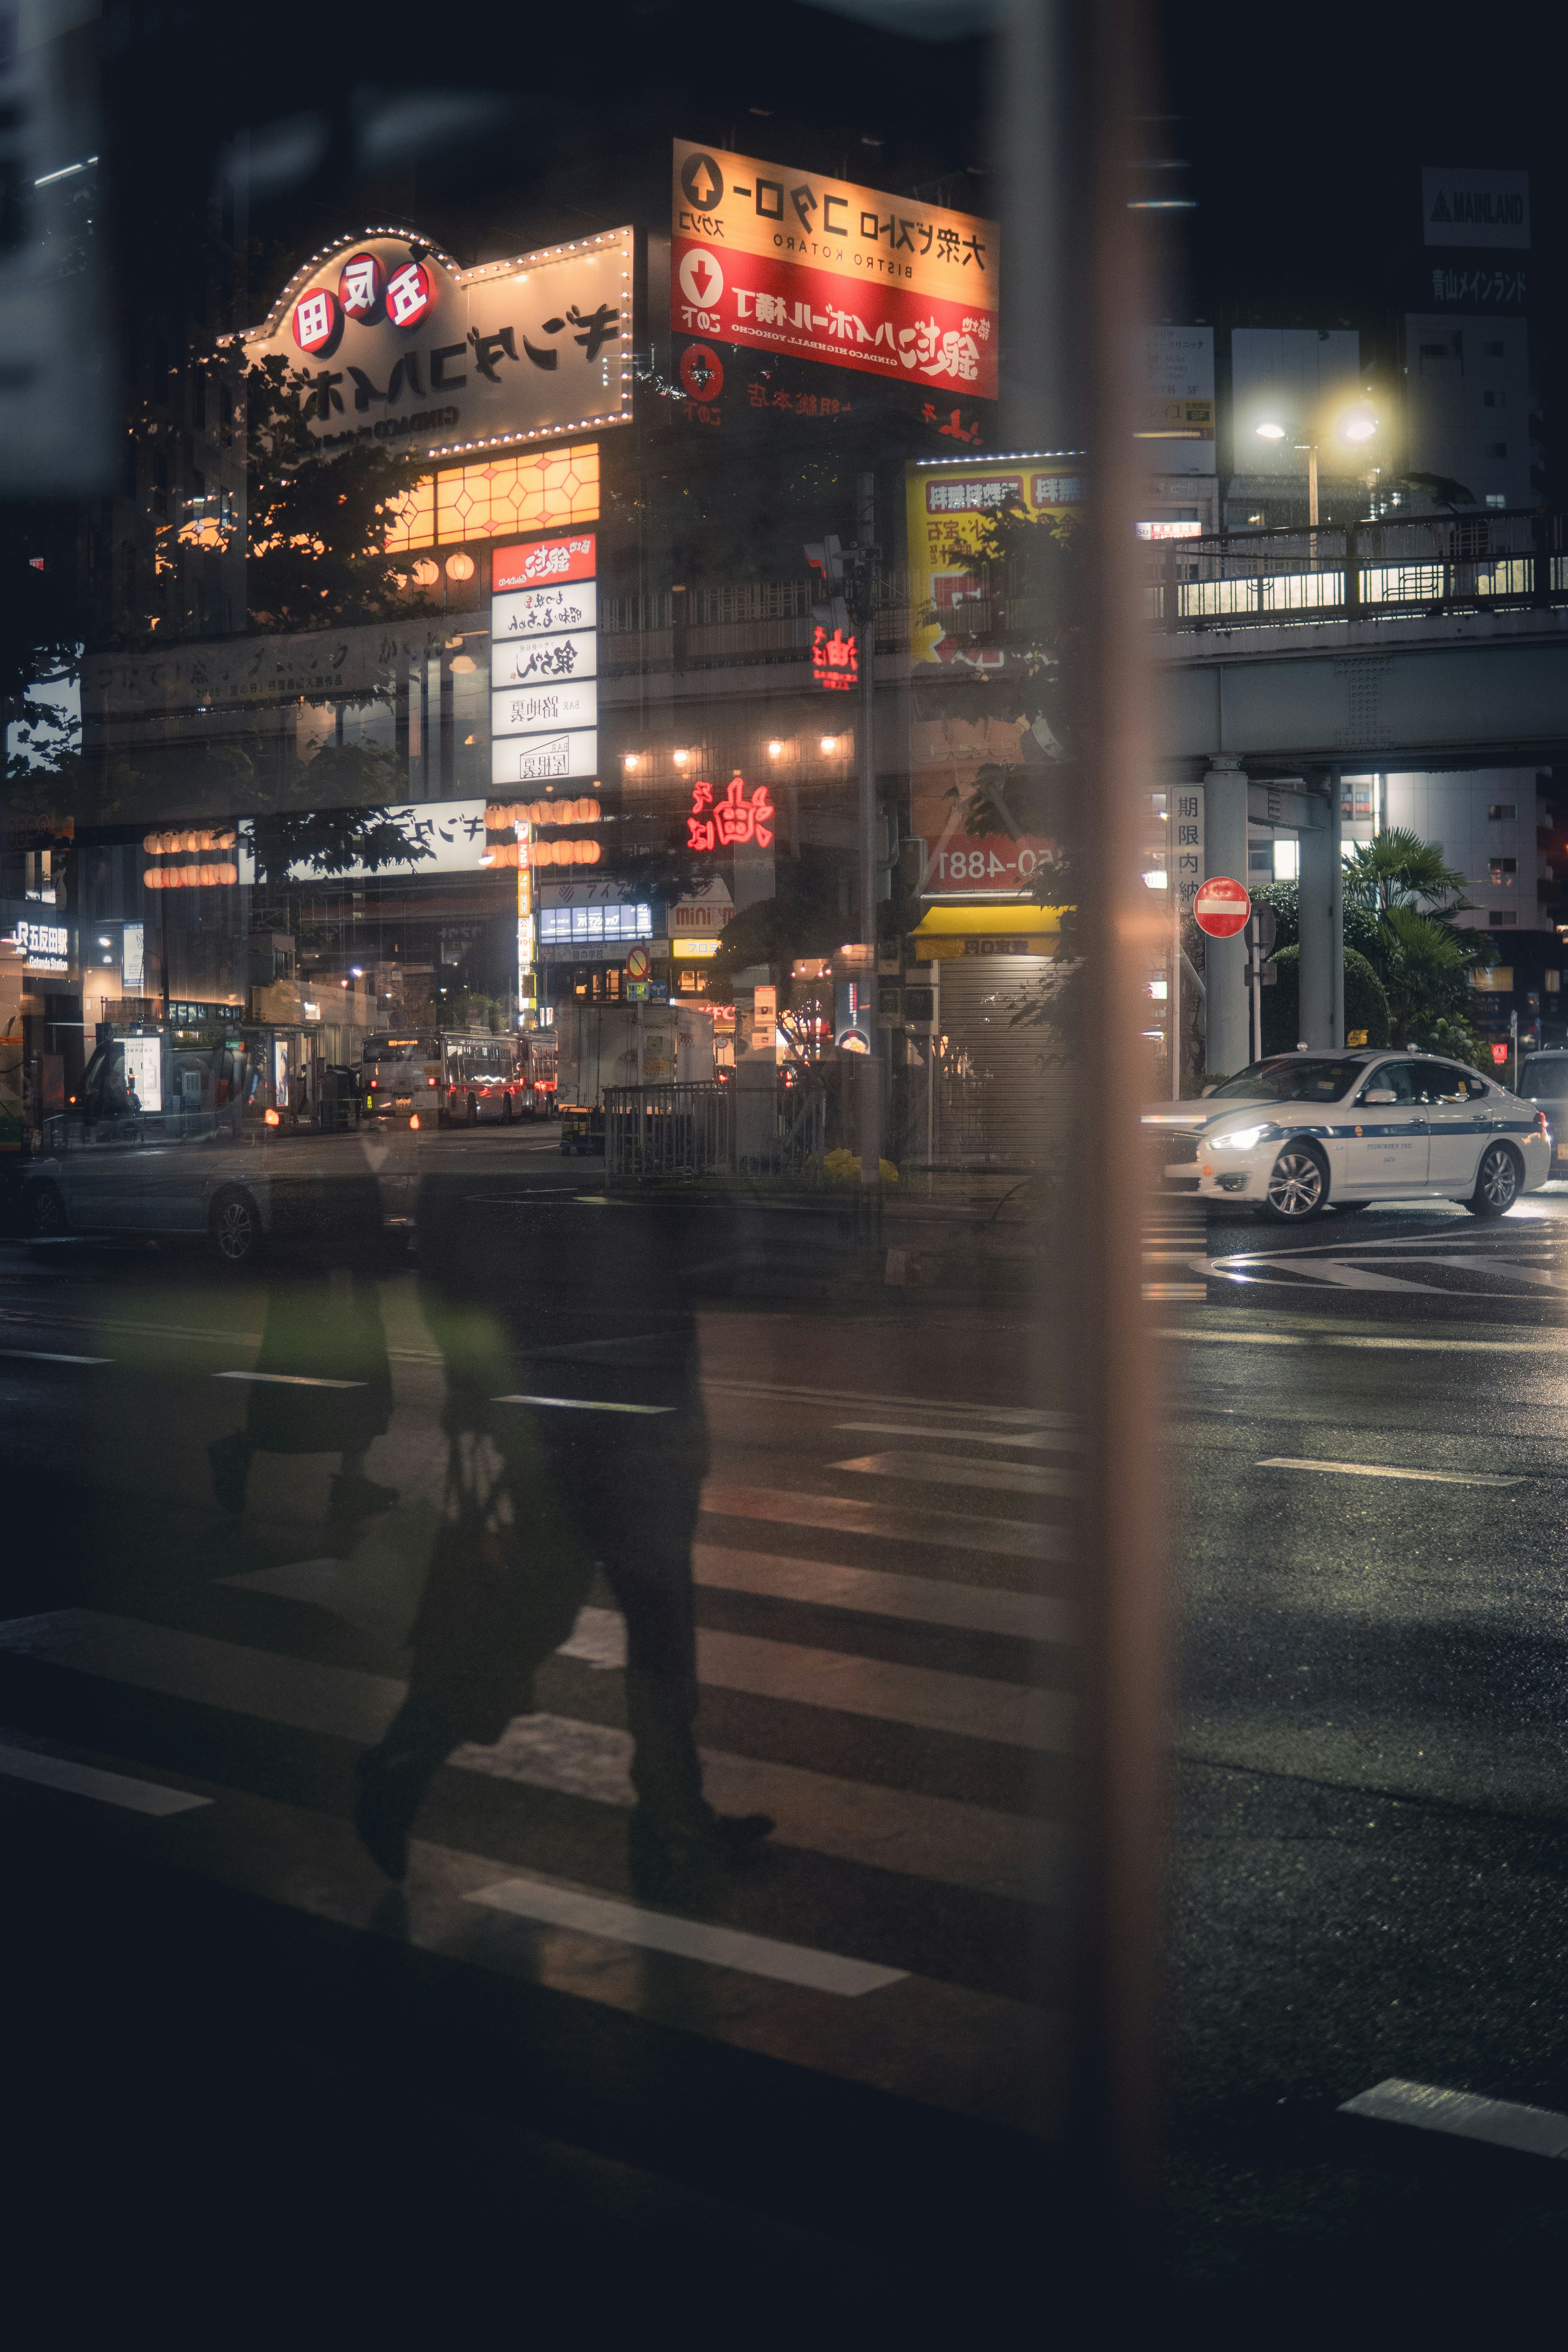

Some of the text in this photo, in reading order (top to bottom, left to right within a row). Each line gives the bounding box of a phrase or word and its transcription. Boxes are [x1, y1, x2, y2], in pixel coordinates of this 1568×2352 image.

[1453, 192, 1523, 225] MAINLAND
[1432, 268, 1526, 302] 青山メインランド
[577, 915, 619, 927] アパマンショップ
[13, 922, 67, 955] JR 五反田駅
[30, 956, 68, 971] Gotanda Station
[573, 950, 604, 960] の学校
